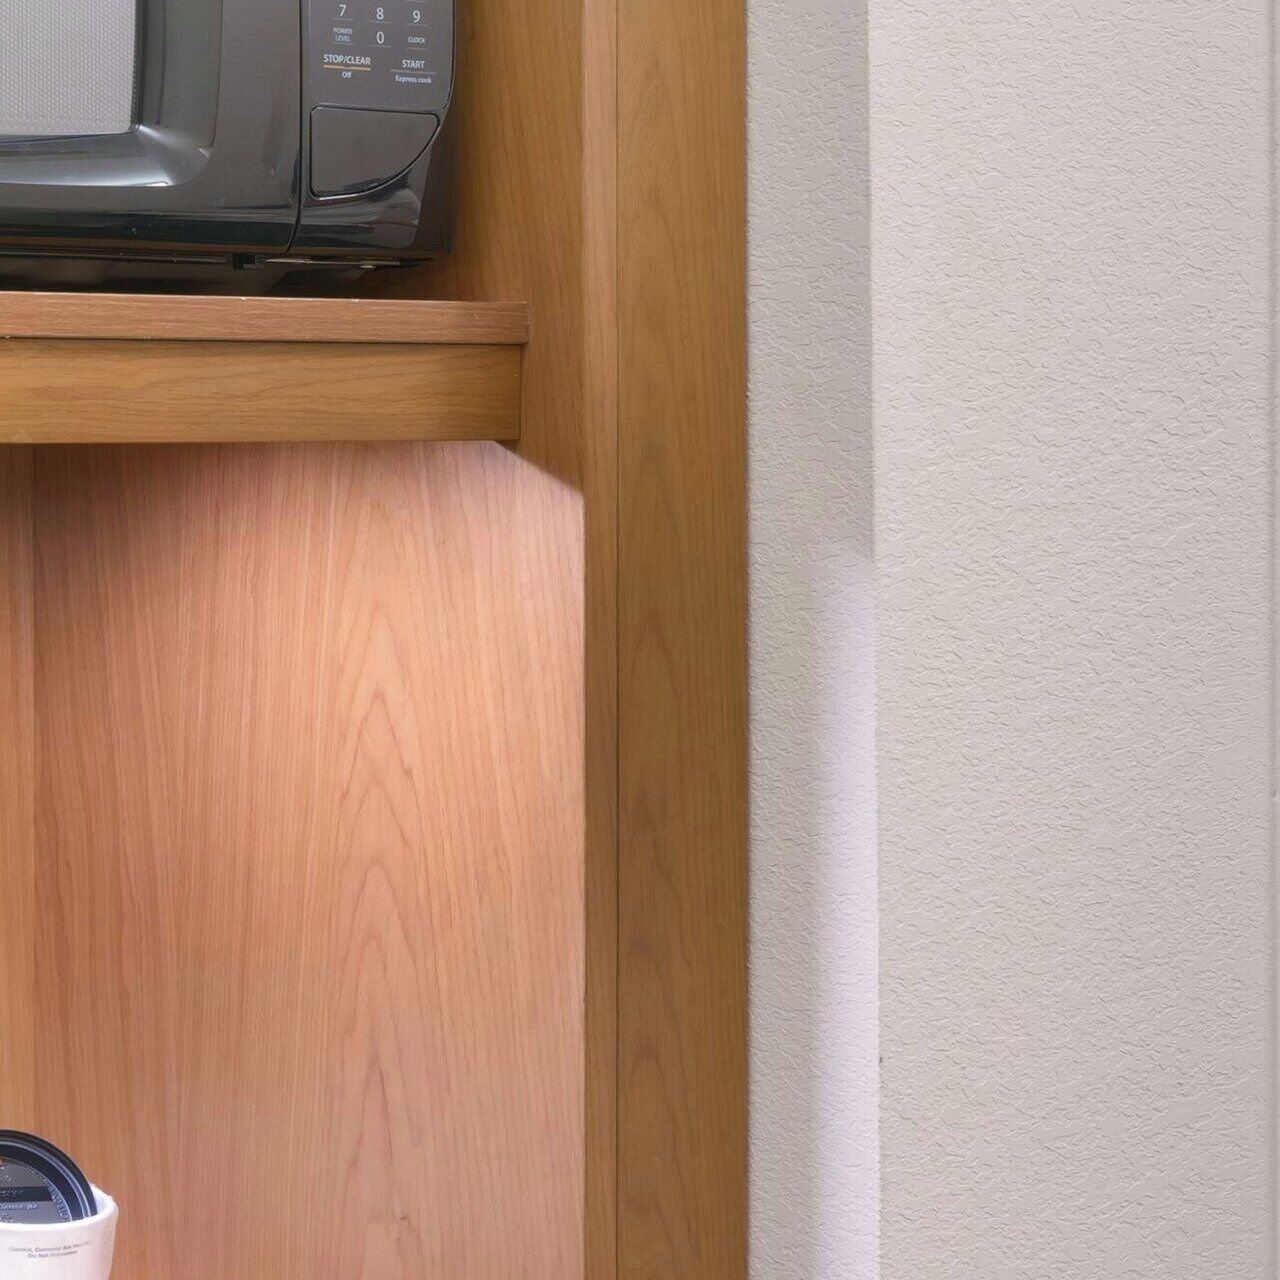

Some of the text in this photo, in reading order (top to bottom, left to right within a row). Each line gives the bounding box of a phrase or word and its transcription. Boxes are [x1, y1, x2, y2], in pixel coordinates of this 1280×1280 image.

[338, 4, 421, 23] 7 8 9
[376, 31, 384, 44] 0
[408, 36, 426, 44] CLOCK
[323, 53, 371, 66] STOP/CLEAR
[402, 59, 426, 69] START
